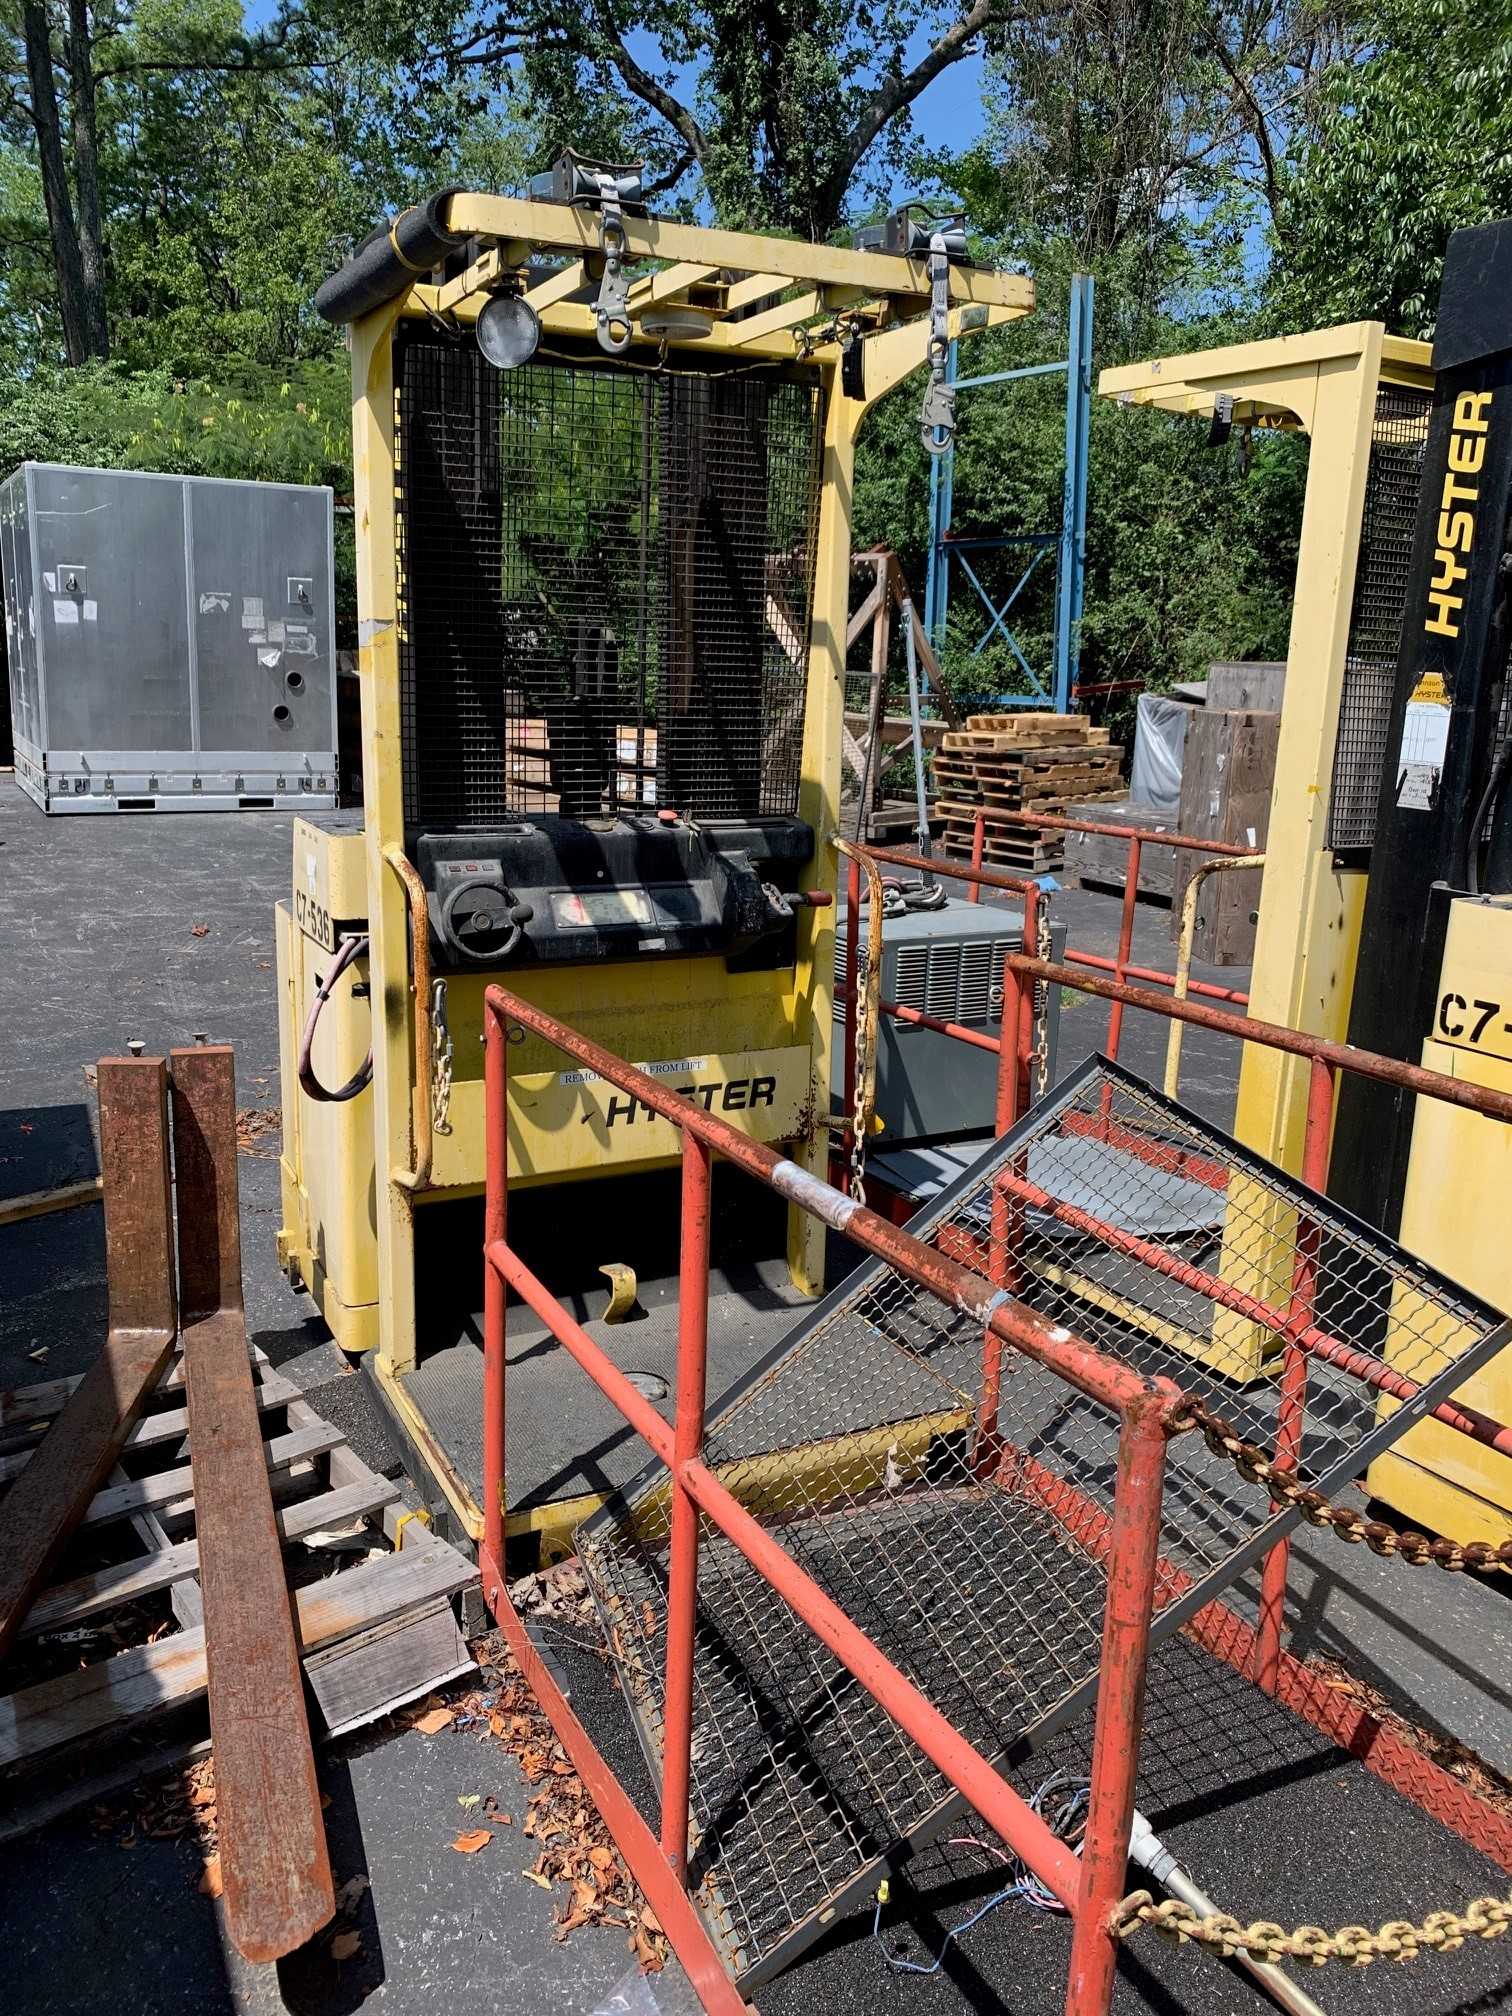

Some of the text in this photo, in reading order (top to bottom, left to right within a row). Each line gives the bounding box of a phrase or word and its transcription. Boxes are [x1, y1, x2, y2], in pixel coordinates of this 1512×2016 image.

[1424, 390, 1493, 638] HYSTER
[296, 889, 330, 945] C7-536
[565, 1072, 602, 1083] REMOV
[650, 1063, 679, 1074] FROM
[681, 1061, 703, 1072] LIFT
